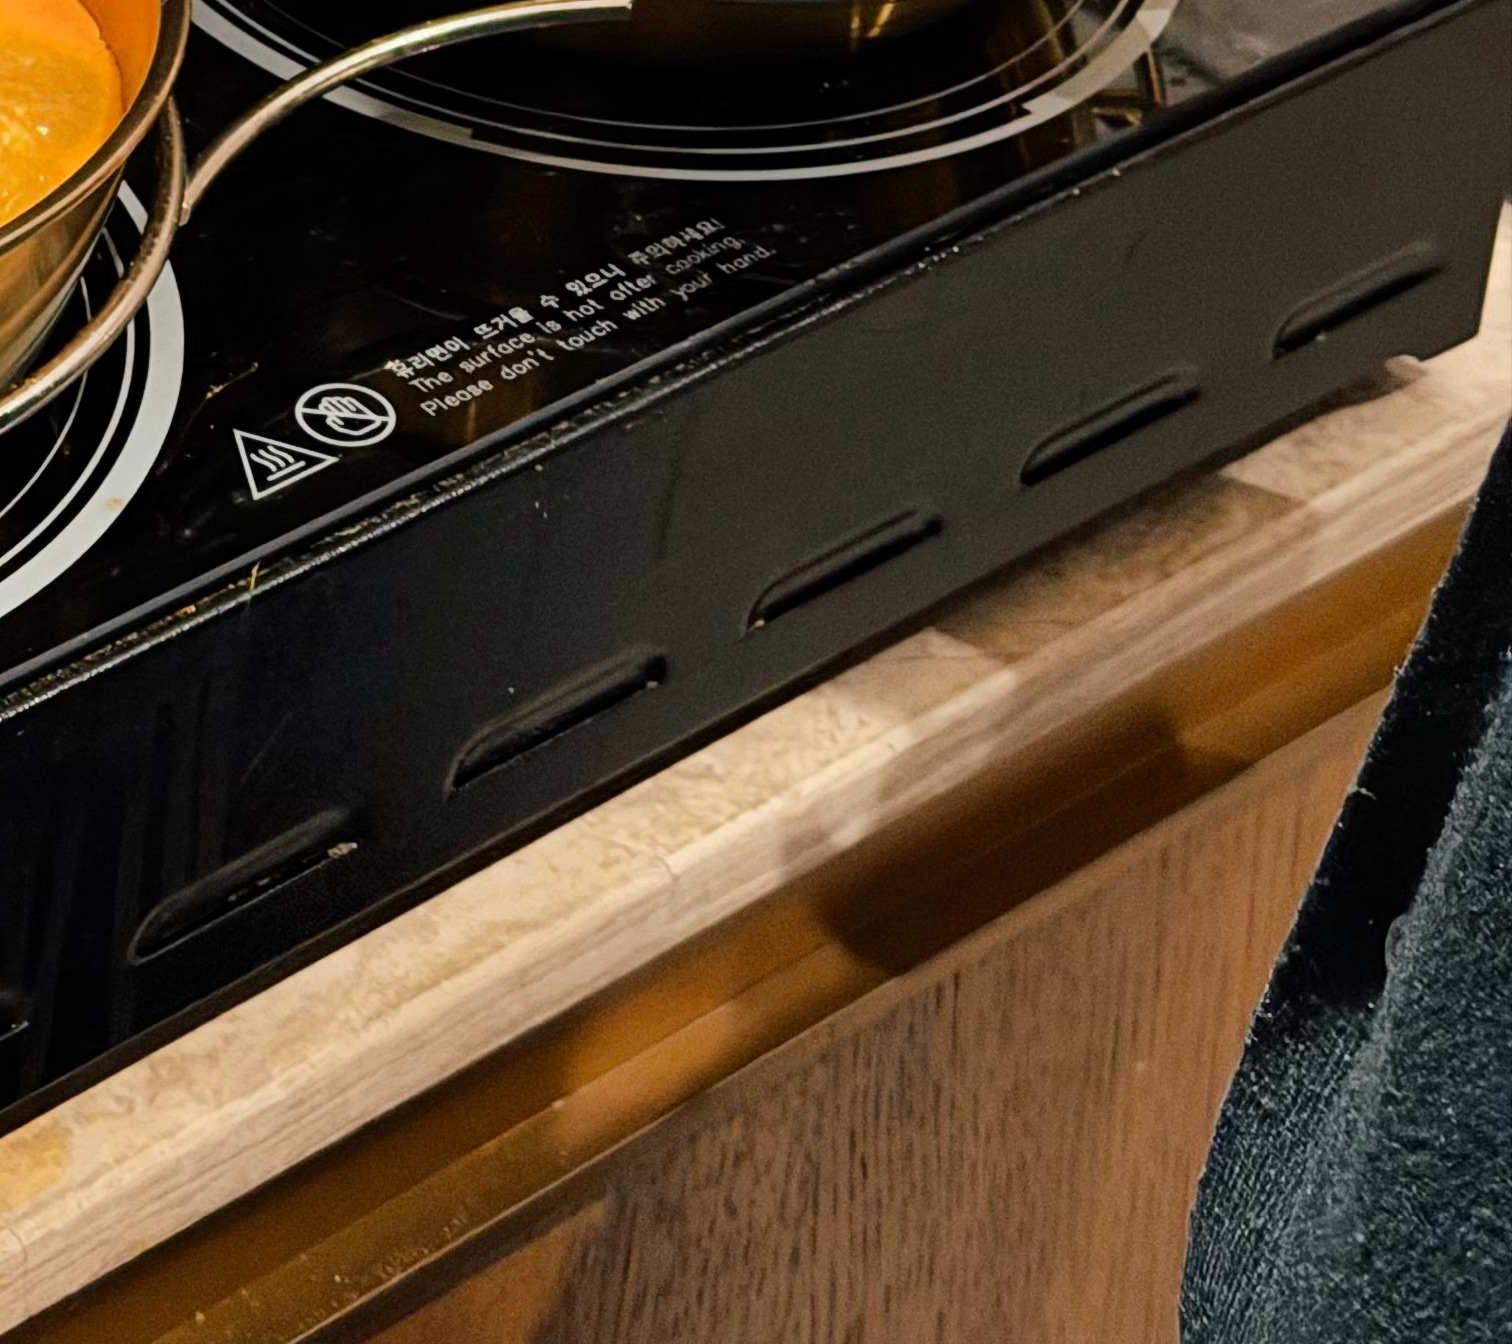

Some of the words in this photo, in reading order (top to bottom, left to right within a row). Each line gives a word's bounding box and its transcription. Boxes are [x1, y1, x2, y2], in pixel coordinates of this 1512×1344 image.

[408, 371, 454, 393] The
[458, 332, 536, 374] surface
[536, 320, 562, 334] is
[562, 298, 605, 322] hot
[609, 274, 657, 301] after
[565, 263, 627, 297] 있으니
[420, 379, 494, 417] Please
[500, 348, 556, 380] don't
[555, 319, 618, 351] touch
[622, 296, 667, 321] with
[670, 272, 714, 302] your
